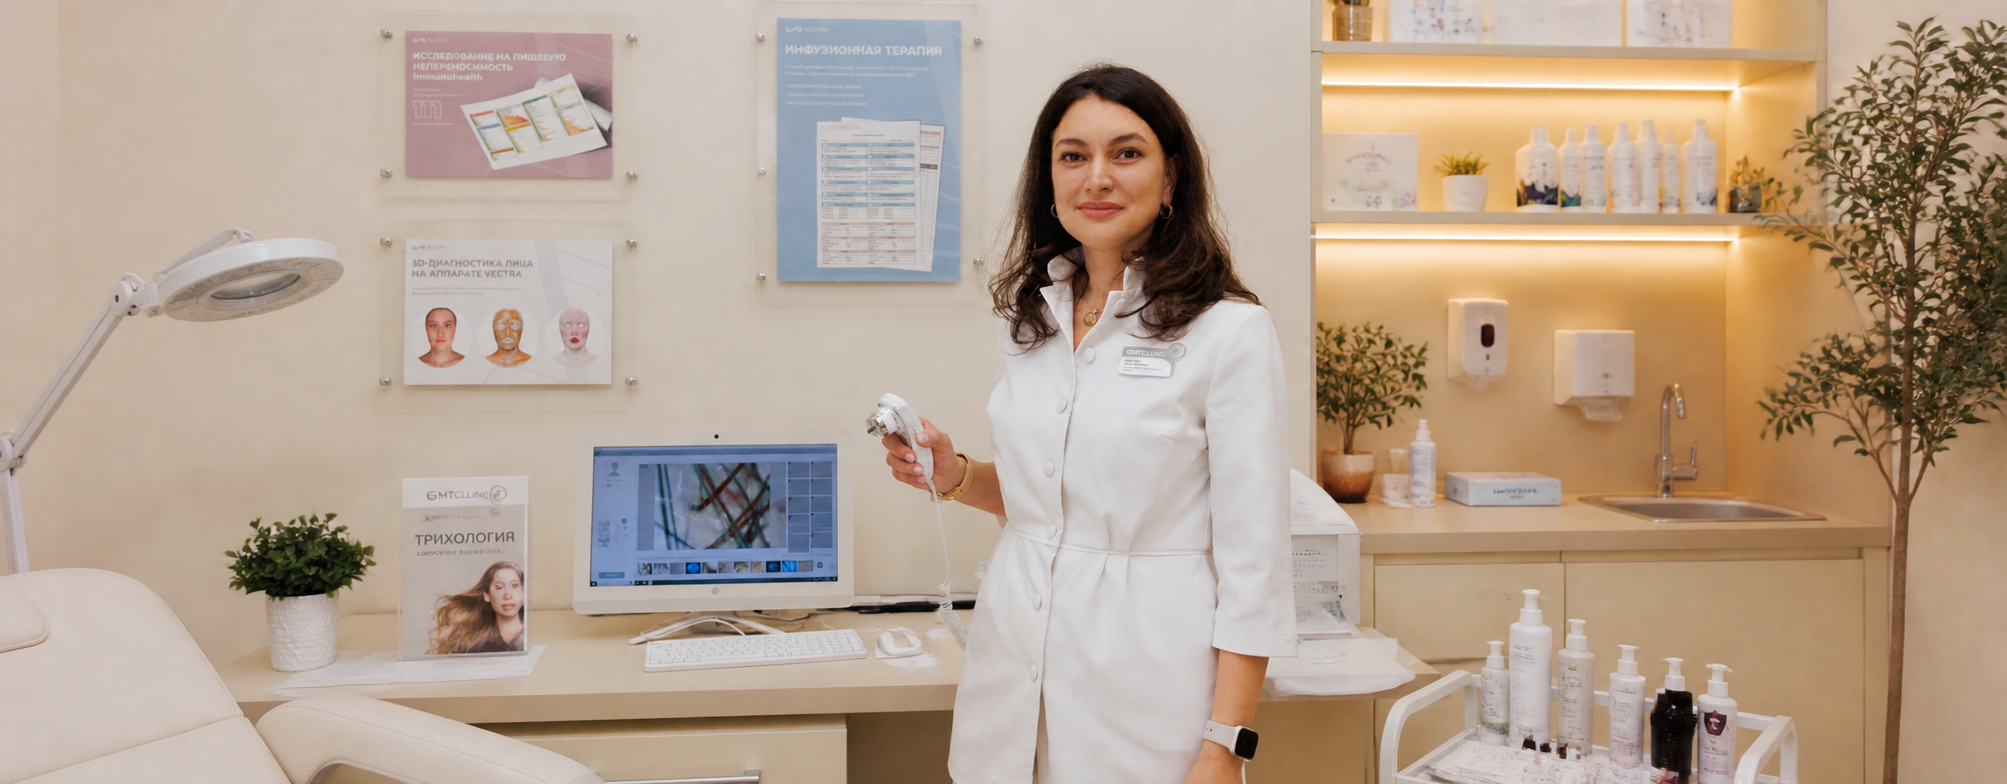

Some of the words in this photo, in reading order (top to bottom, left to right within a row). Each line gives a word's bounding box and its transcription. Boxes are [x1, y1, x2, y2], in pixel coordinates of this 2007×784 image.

[785, 44, 881, 55] ИНФУЗИОННАЯ
[885, 45, 943, 56] ТЕРАПИЯ
[413, 52, 494, 61] ИССЛЕДОВАНИЕ
[496, 52, 511, 61] НА
[513, 53, 567, 62] ПИЩЕВУЮ
[413, 63, 514, 71] НЕПЕРЕНОСИМОСТЬ
[413, 73, 483, 81] Immunohealth
[412, 259, 503, 268] 3D-ДИАГНОСТИКА
[505, 259, 534, 269] ЛИЦА
[412, 270, 427, 278] НА
[429, 270, 482, 278] АППАРАТЕ
[484, 270, 523, 278] VECTRA
[415, 531, 515, 546] ТРИХОЛОГИЯ
